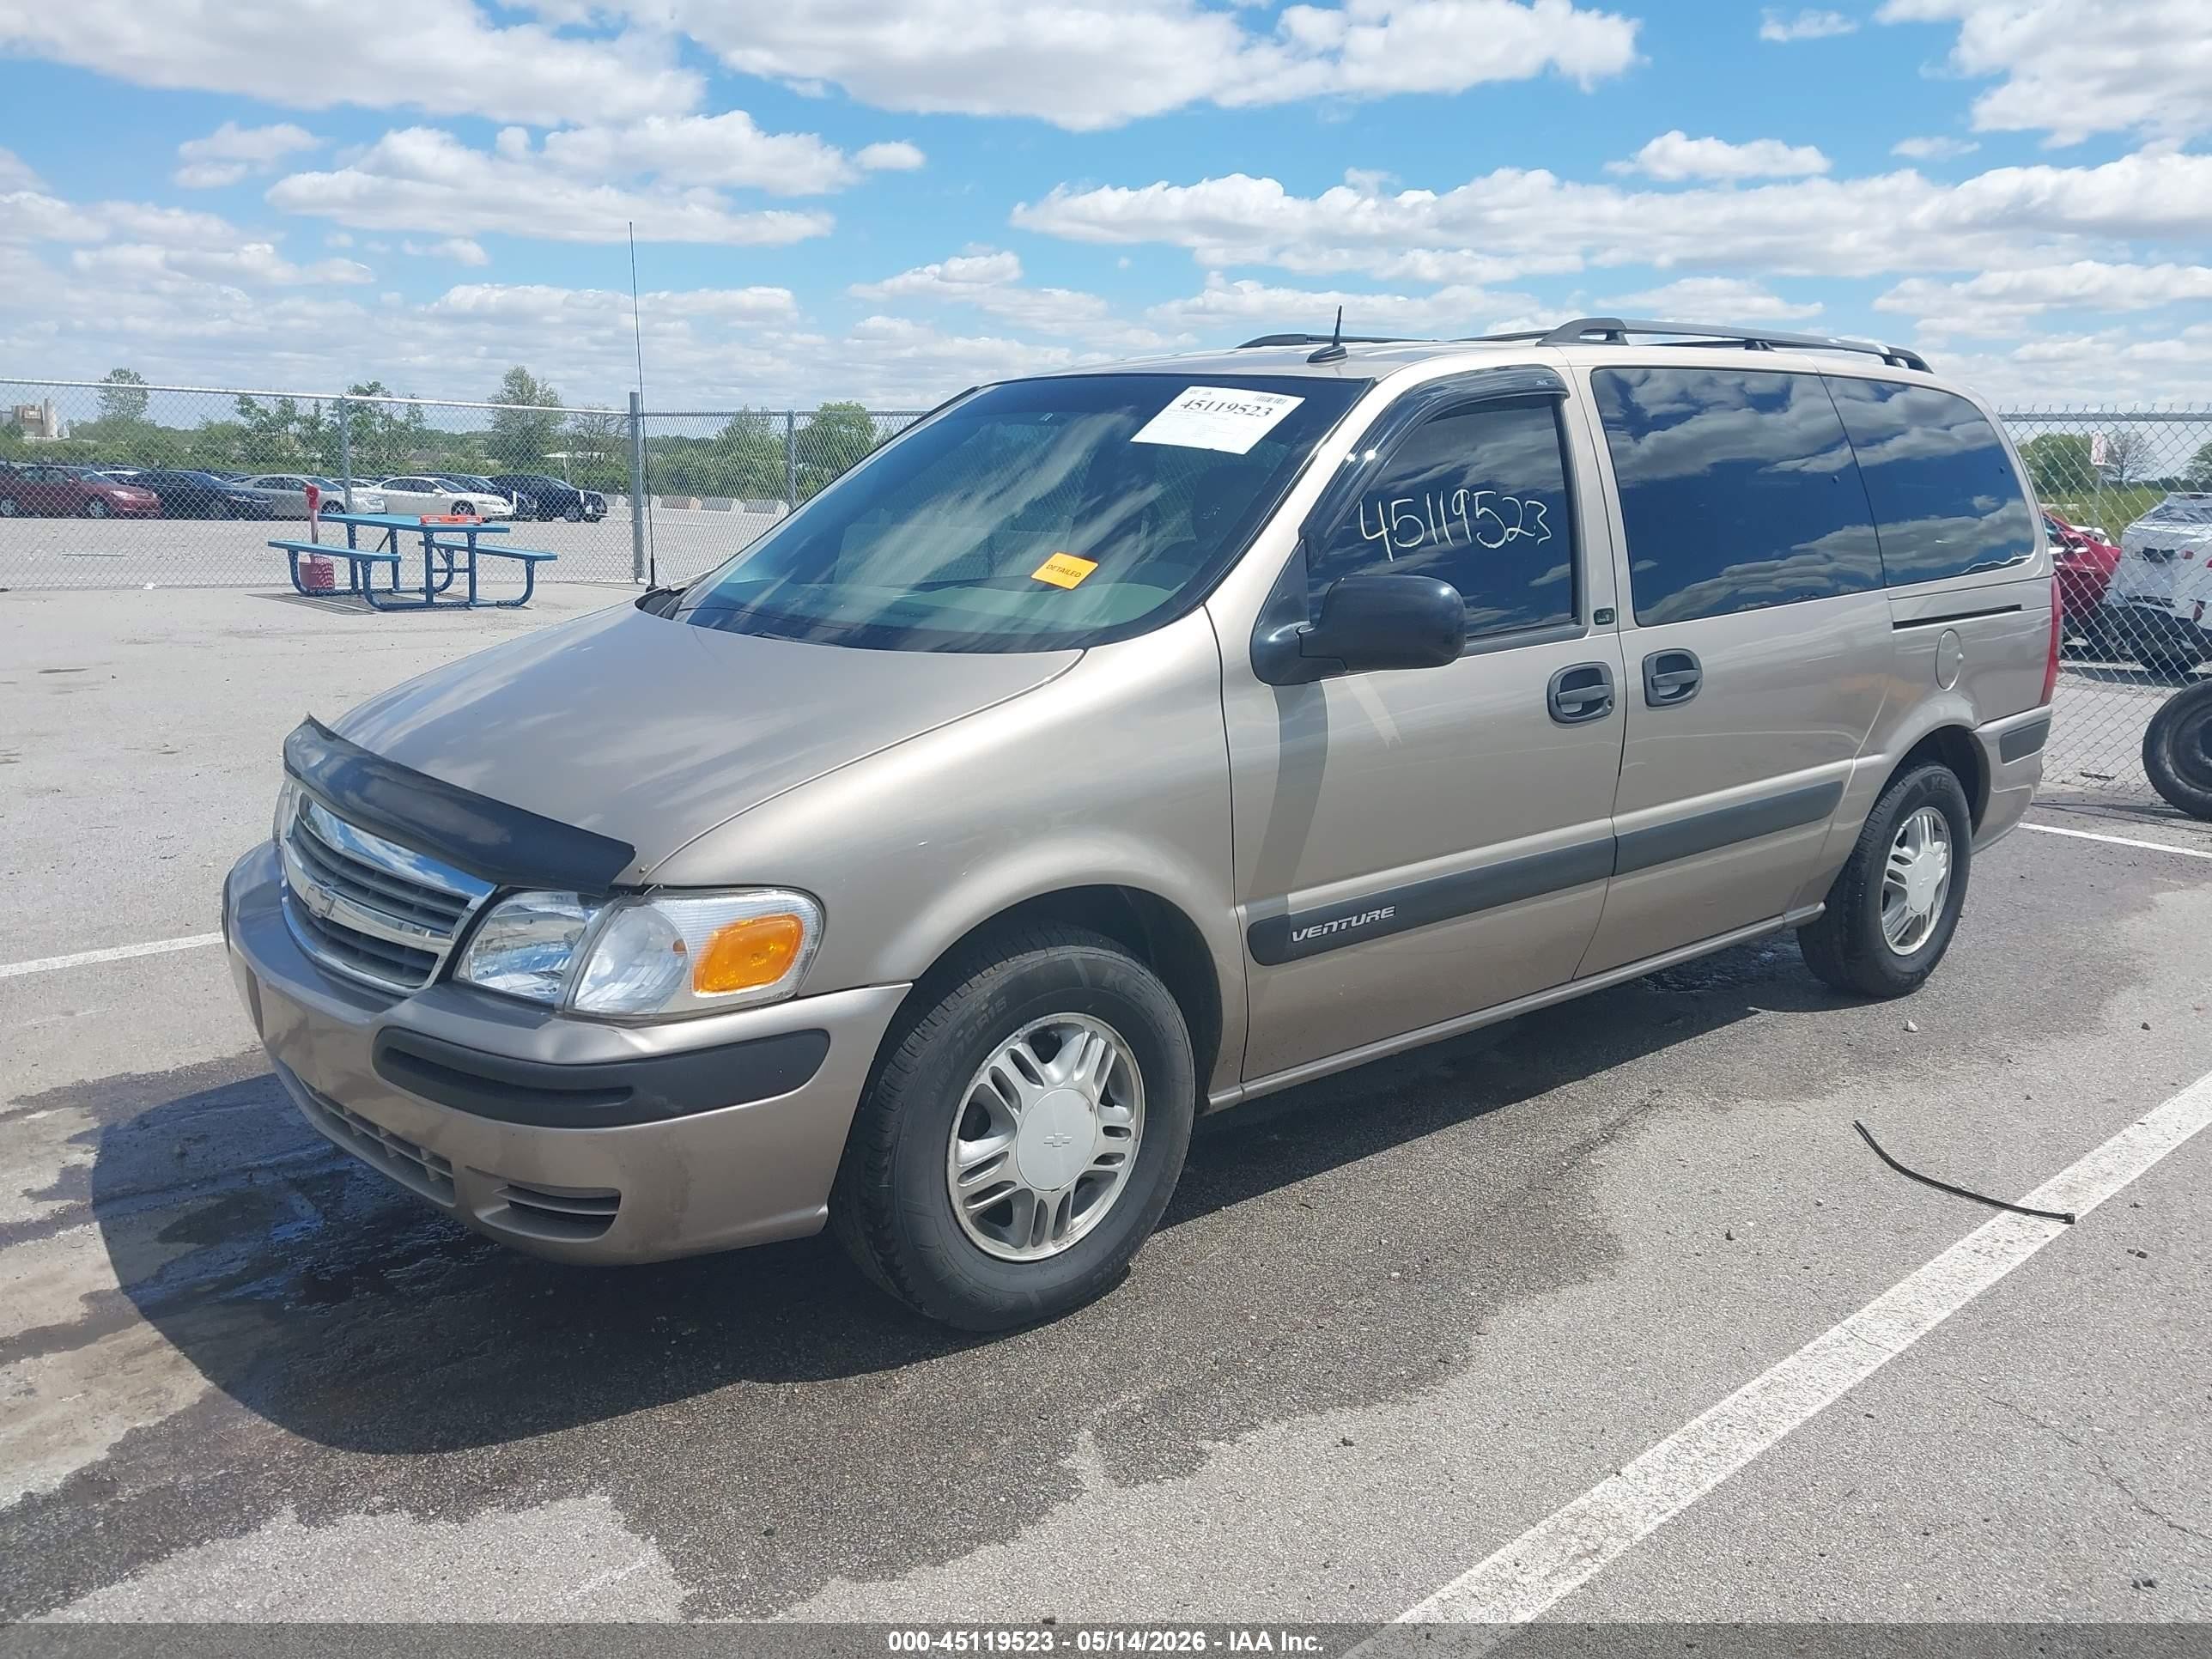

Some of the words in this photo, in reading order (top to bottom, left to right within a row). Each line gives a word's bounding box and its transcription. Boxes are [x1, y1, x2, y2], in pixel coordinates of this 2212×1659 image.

[1180, 398, 1273, 417] 45119523
[1359, 489, 1552, 562] 45119523
[1046, 564, 1082, 578] DETAILED
[1292, 906, 1395, 942] VENTURE
